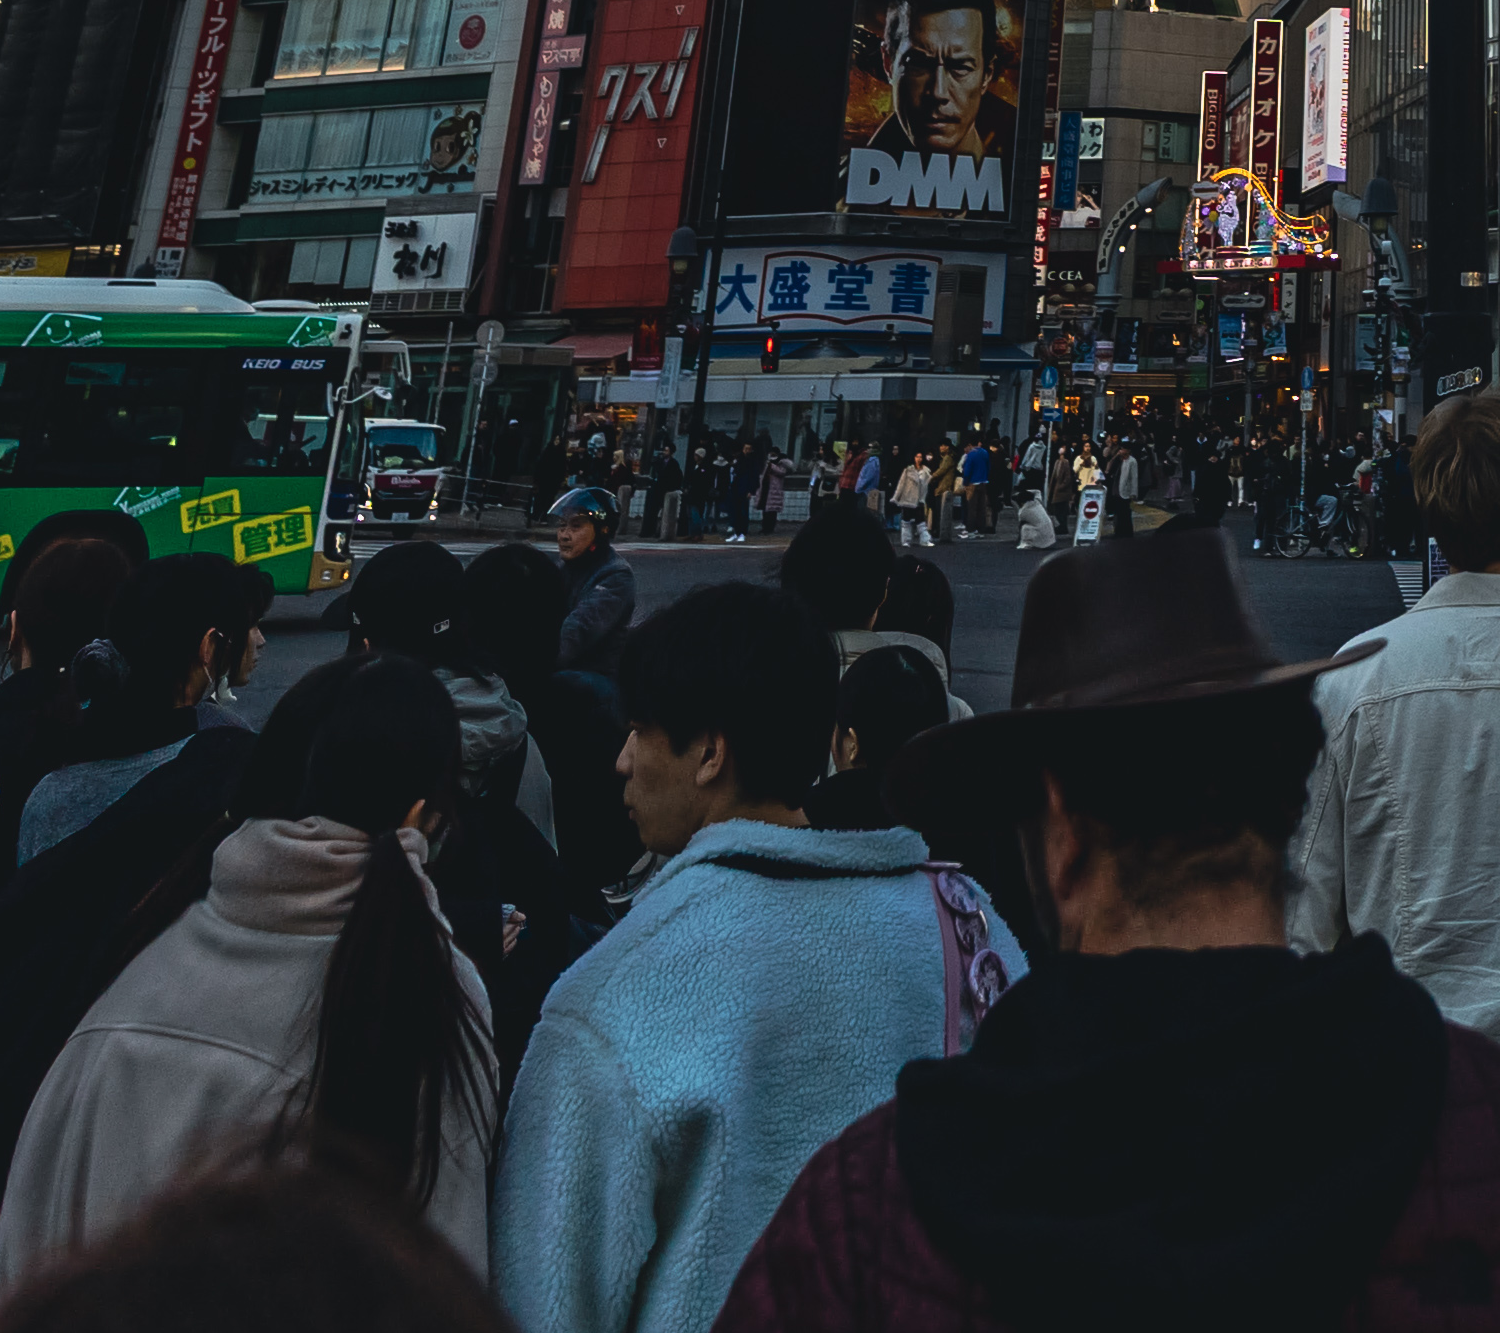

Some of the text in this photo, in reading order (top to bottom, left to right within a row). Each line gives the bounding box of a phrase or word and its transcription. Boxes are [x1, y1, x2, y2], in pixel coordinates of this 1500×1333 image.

[1253, 36, 1278, 149] カラオケ
[844, 147, 1006, 214] DMM
[241, 358, 327, 371] KEIO BUS
[240, 513, 307, 554] 管理
